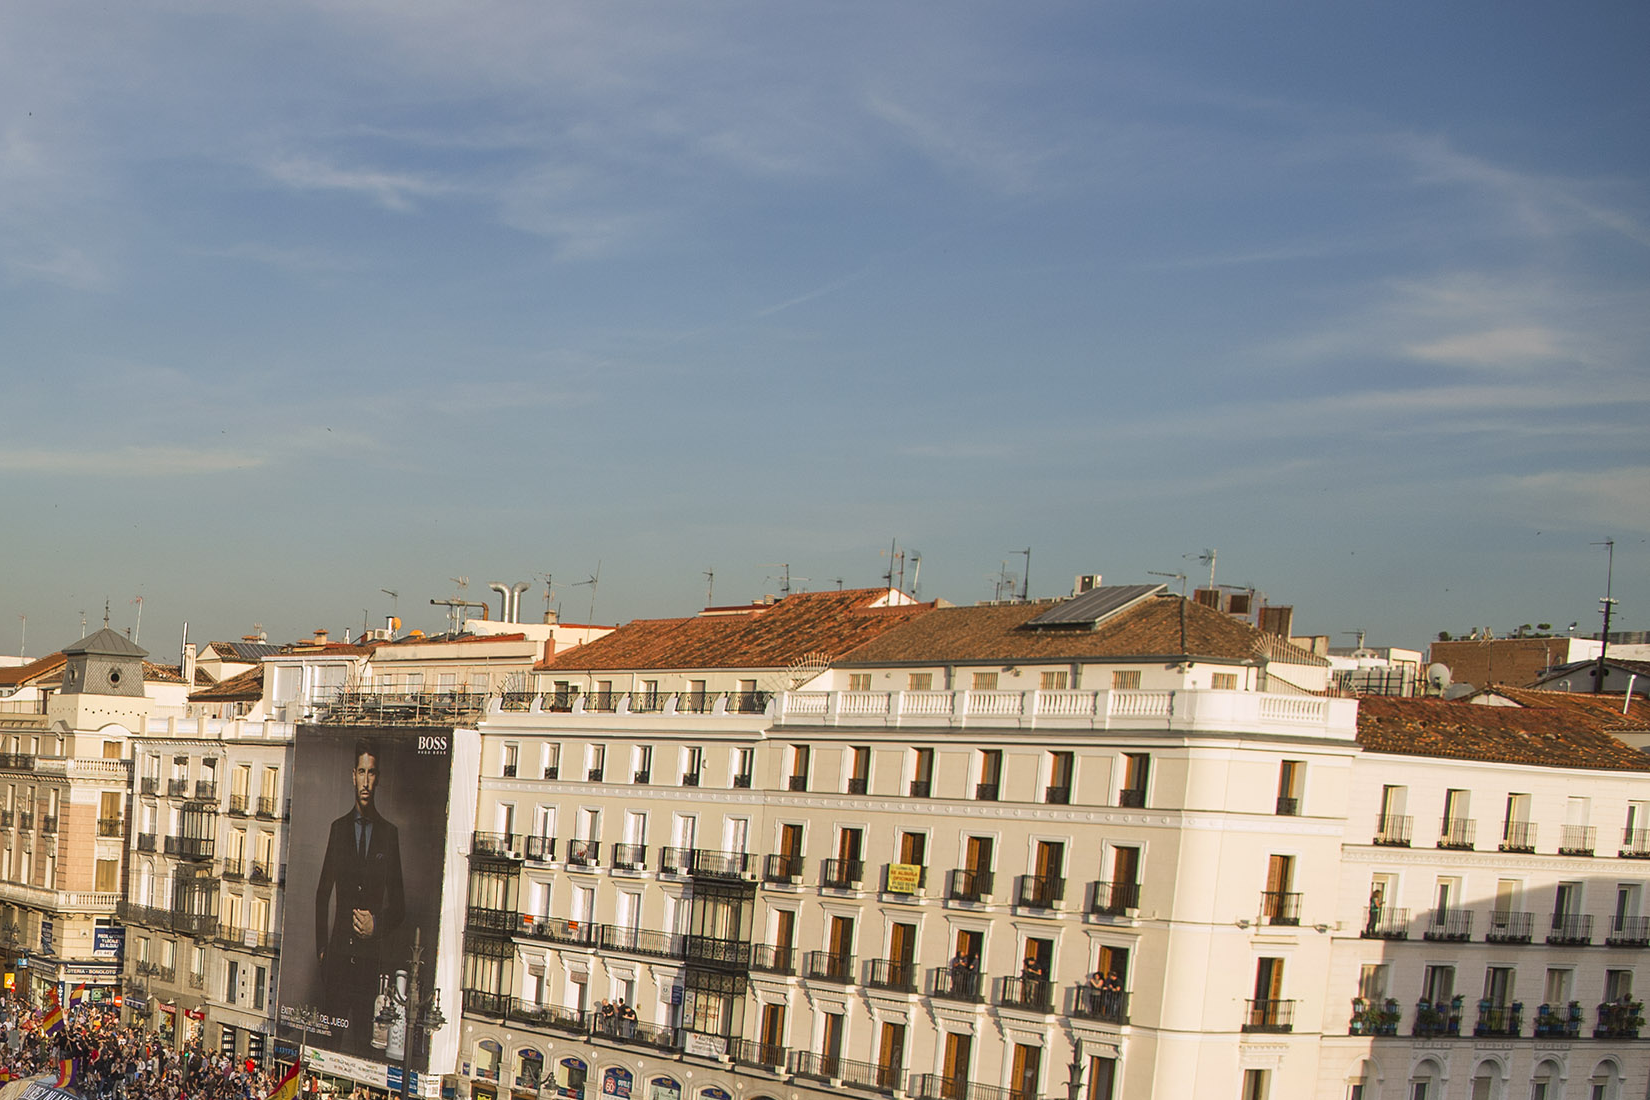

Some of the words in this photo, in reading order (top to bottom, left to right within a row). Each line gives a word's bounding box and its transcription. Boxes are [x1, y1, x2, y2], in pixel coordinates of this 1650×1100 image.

[418, 736, 447, 750] BOSS
[320, 1014, 329, 1024] DEL
[331, 1016, 349, 1028] JUEGO
